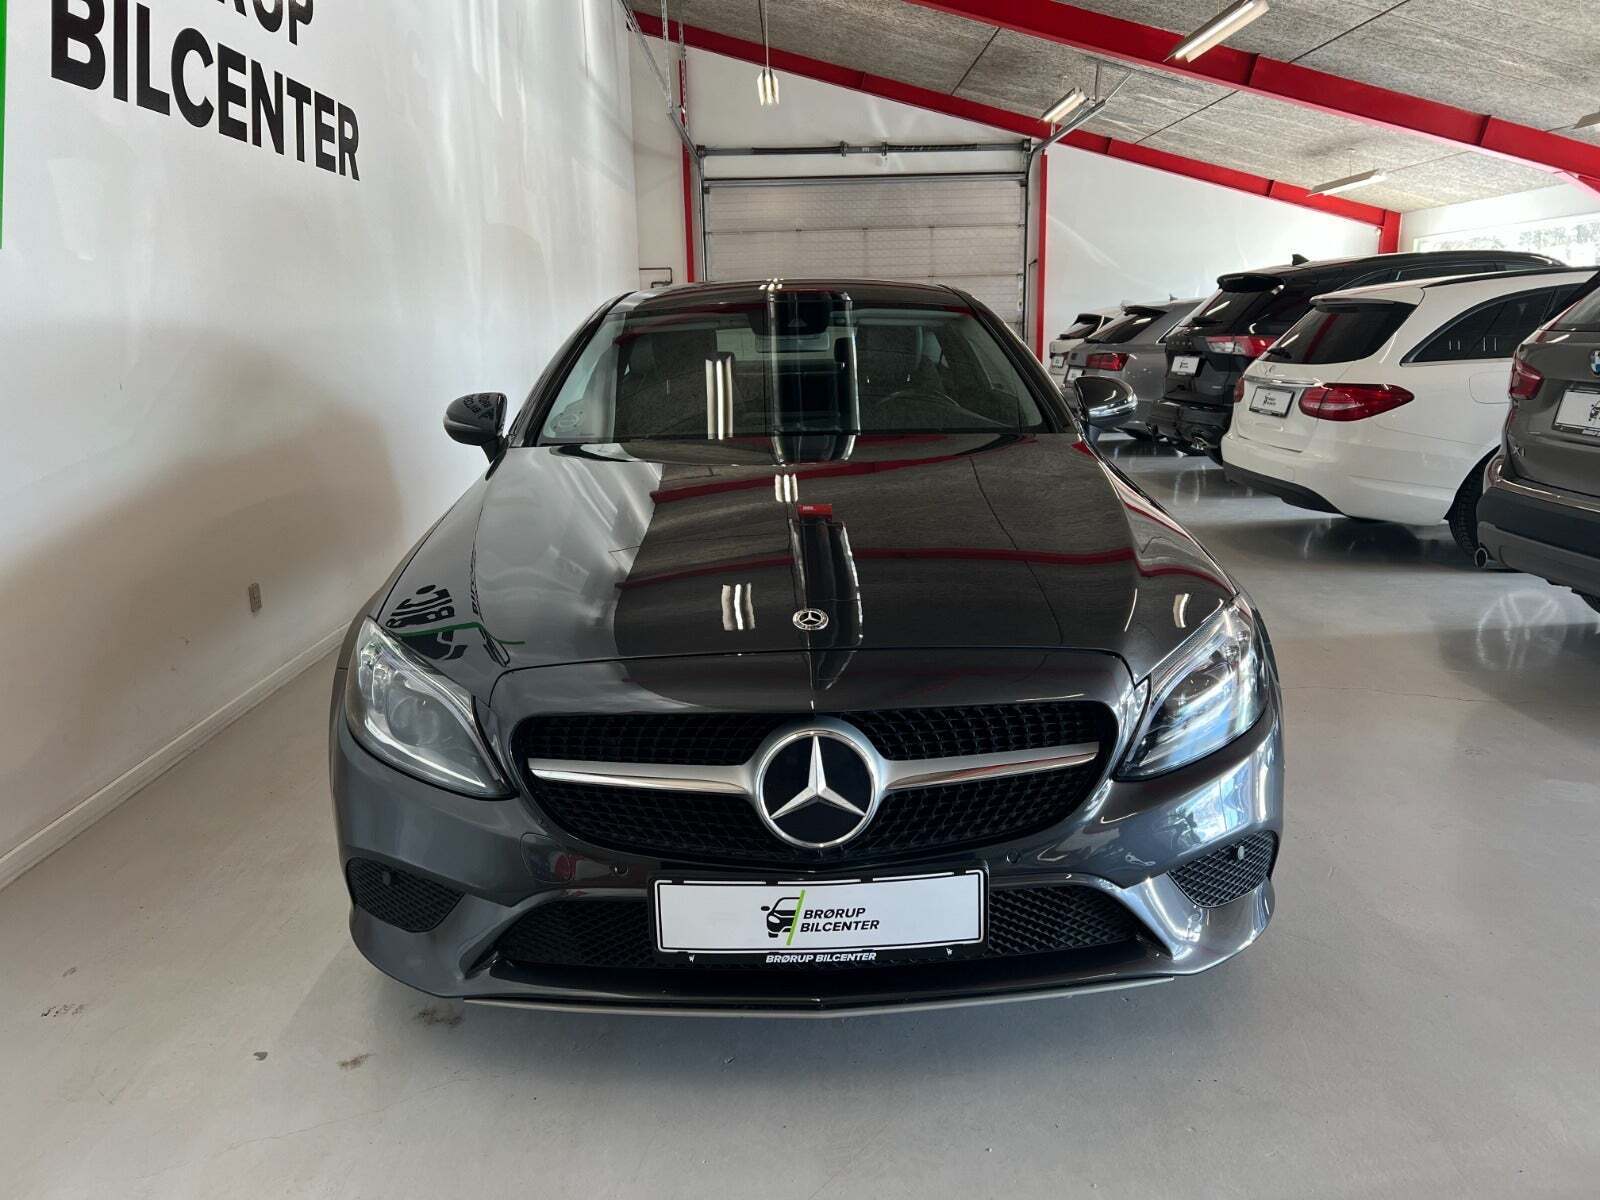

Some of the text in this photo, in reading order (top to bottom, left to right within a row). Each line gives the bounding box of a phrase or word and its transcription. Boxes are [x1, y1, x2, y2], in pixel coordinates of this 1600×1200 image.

[51, 0, 360, 181] BILCENTER
[803, 907, 866, 920] BRØRUP
[799, 920, 880, 933] BILCENTER
[765, 952, 877, 964] BRØRUP BILCENTER
